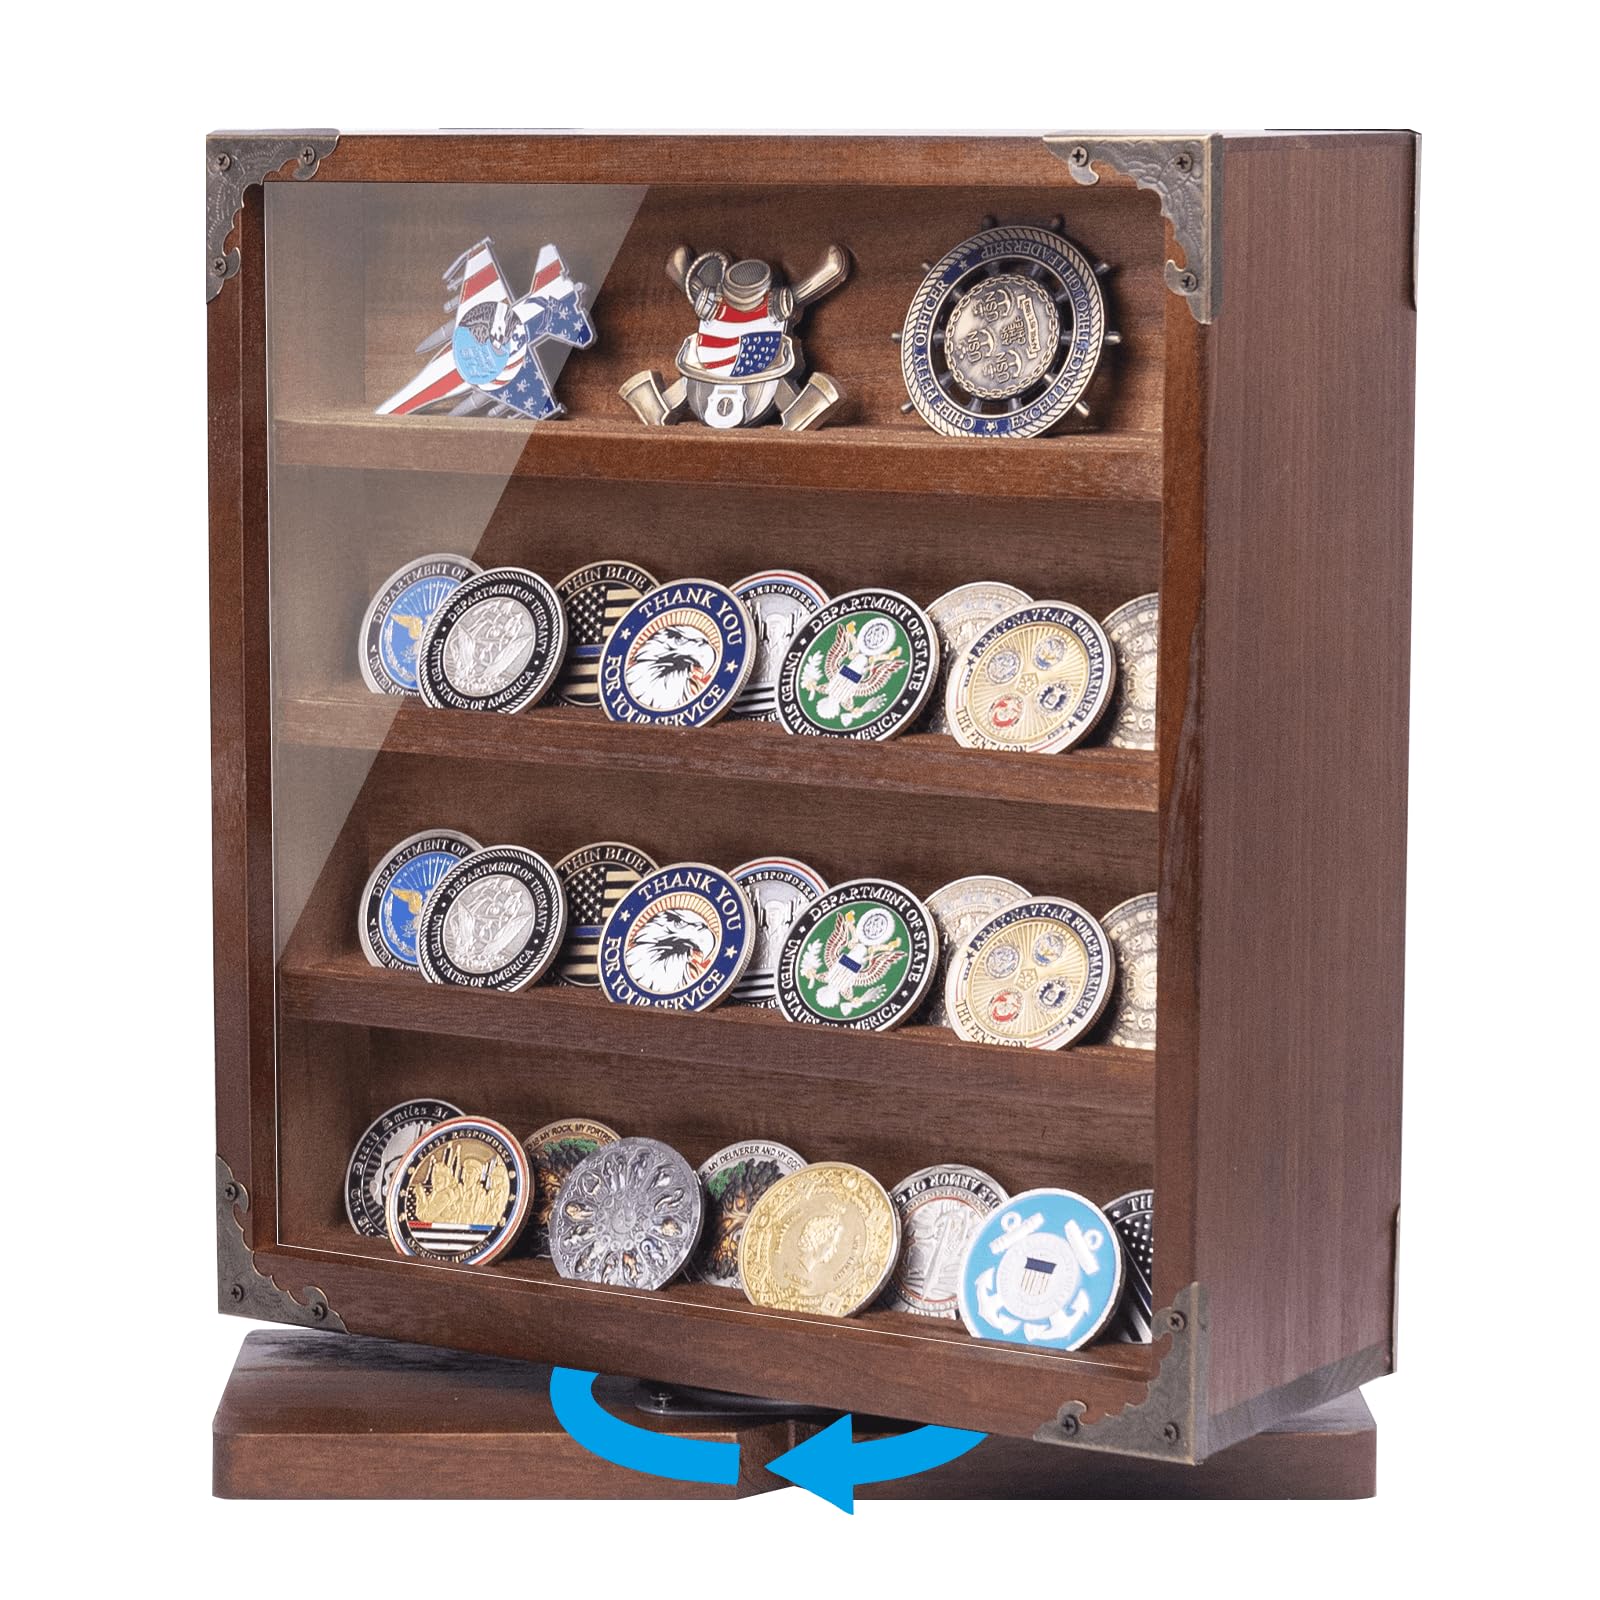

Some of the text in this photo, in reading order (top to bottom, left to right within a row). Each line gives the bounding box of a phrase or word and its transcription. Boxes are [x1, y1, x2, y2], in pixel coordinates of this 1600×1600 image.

[985, 291, 999, 323] USN
[914, 279, 976, 431] CHIEF PETTY OFFICER
[967, 330, 982, 363] USN
[996, 352, 1010, 384] USN
[1009, 349, 1086, 429] EXCELLENCE
[373, 563, 469, 624] DEPARTMENT OF
[561, 565, 647, 596] THIN BLUE
[447, 583, 521, 622] DEPARTMENT
[519, 590, 535, 602] OF
[638, 587, 743, 646] THANK YOU
[809, 595, 929, 692] DEPARTMENT OF STATE
[1072, 619, 1101, 657] FORCE
[369, 654, 392, 693] UNITED
[430, 638, 535, 711] UNITED STATES OF AMERICA
[604, 654, 623, 697] FOR
[1075, 656, 1105, 720] MARINES
[780, 650, 802, 702] UNITED
[843, 712, 902, 741] MERICA
[955, 705, 972, 733] THE
[373, 839, 469, 899] DEPARTMENT OF
[447, 861, 521, 899] DEPARTMENT
[519, 867, 535, 881] OF
[560, 846, 646, 875] THIN BLUE
[637, 871, 742, 931] THANK YOU
[369, 928, 392, 967] UNITED
[430, 914, 535, 988] UNITED STATES OF AMERICA
[809, 885, 928, 983] DEPARTMENT OF STATE
[1071, 915, 1099, 953] FORCE
[604, 936, 623, 978] FOR
[780, 938, 801, 990] UNITED
[843, 1003, 902, 1031] MERICA
[1074, 953, 1104, 1017] MARINES
[955, 999, 972, 1028] THE
[575, 1122, 586, 1131] MY
[708, 1159, 719, 1172] MY
[719, 1145, 760, 1164] DELIVERER
[761, 1145, 777, 1156] AND
[929, 1172, 982, 1191] ARMOR
